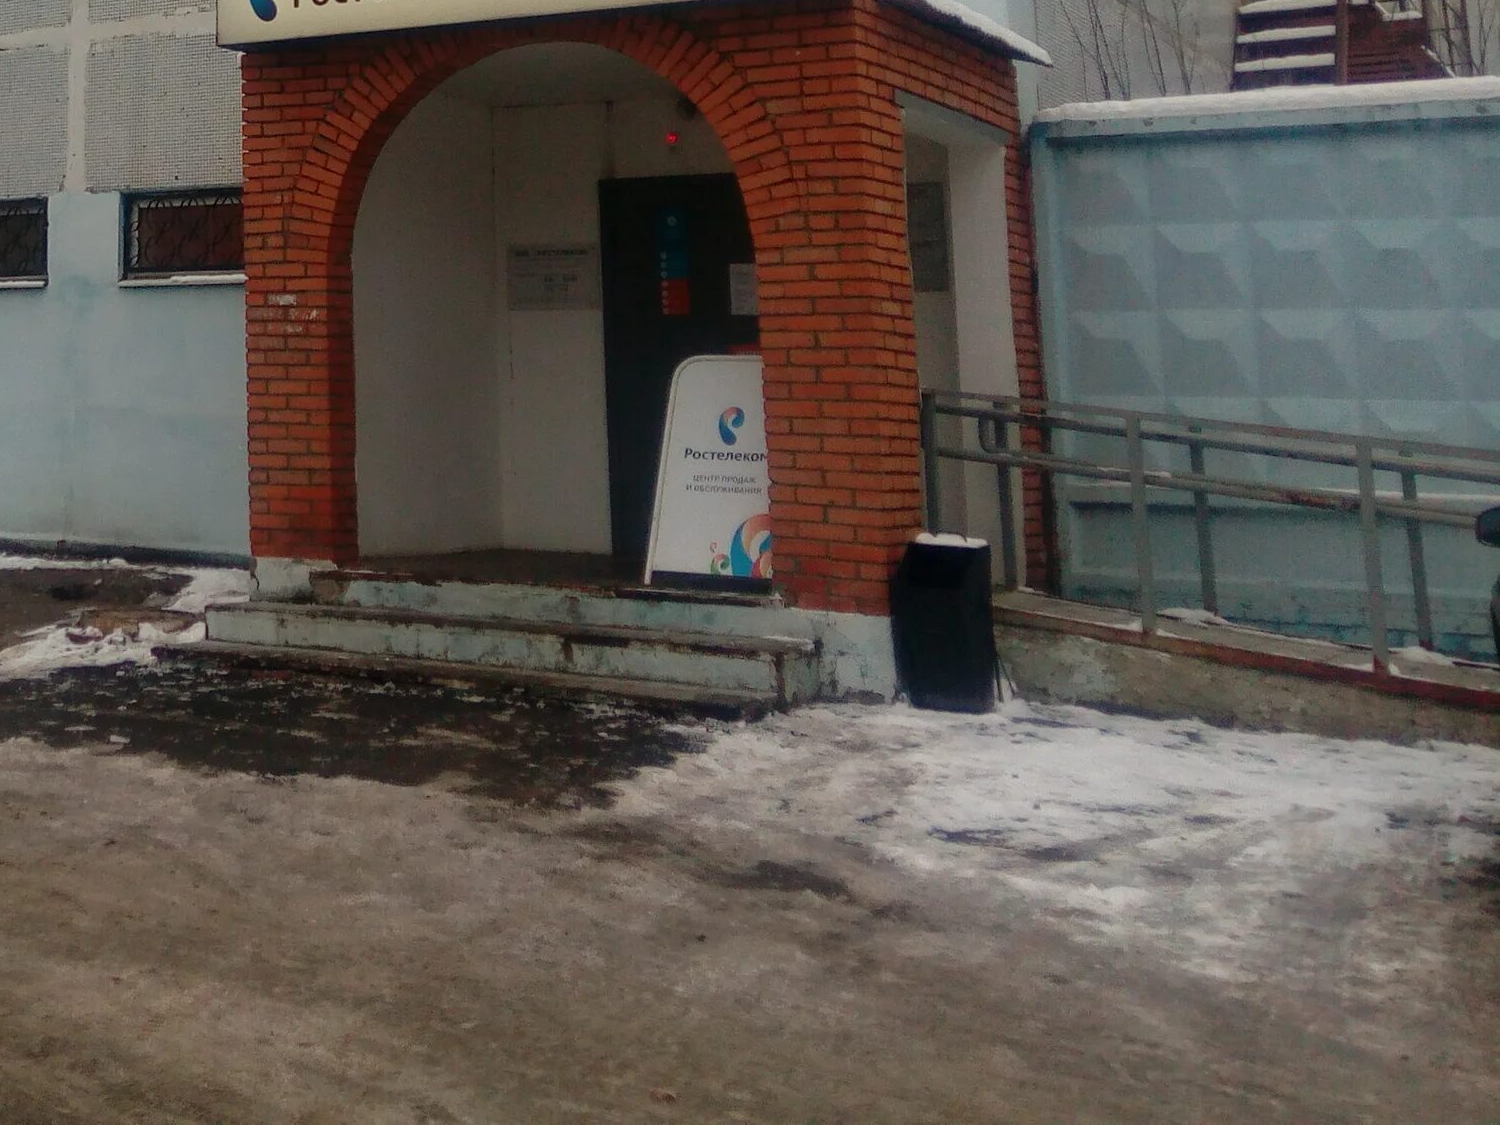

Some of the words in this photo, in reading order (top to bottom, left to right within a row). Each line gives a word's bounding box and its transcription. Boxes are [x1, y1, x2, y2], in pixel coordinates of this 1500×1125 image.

[693, 474, 720, 483] ЦЕНТР
[721, 475, 757, 484] ПРОДАЖ
[693, 484, 763, 495] ОБСЛУЖИВАНИЯ
